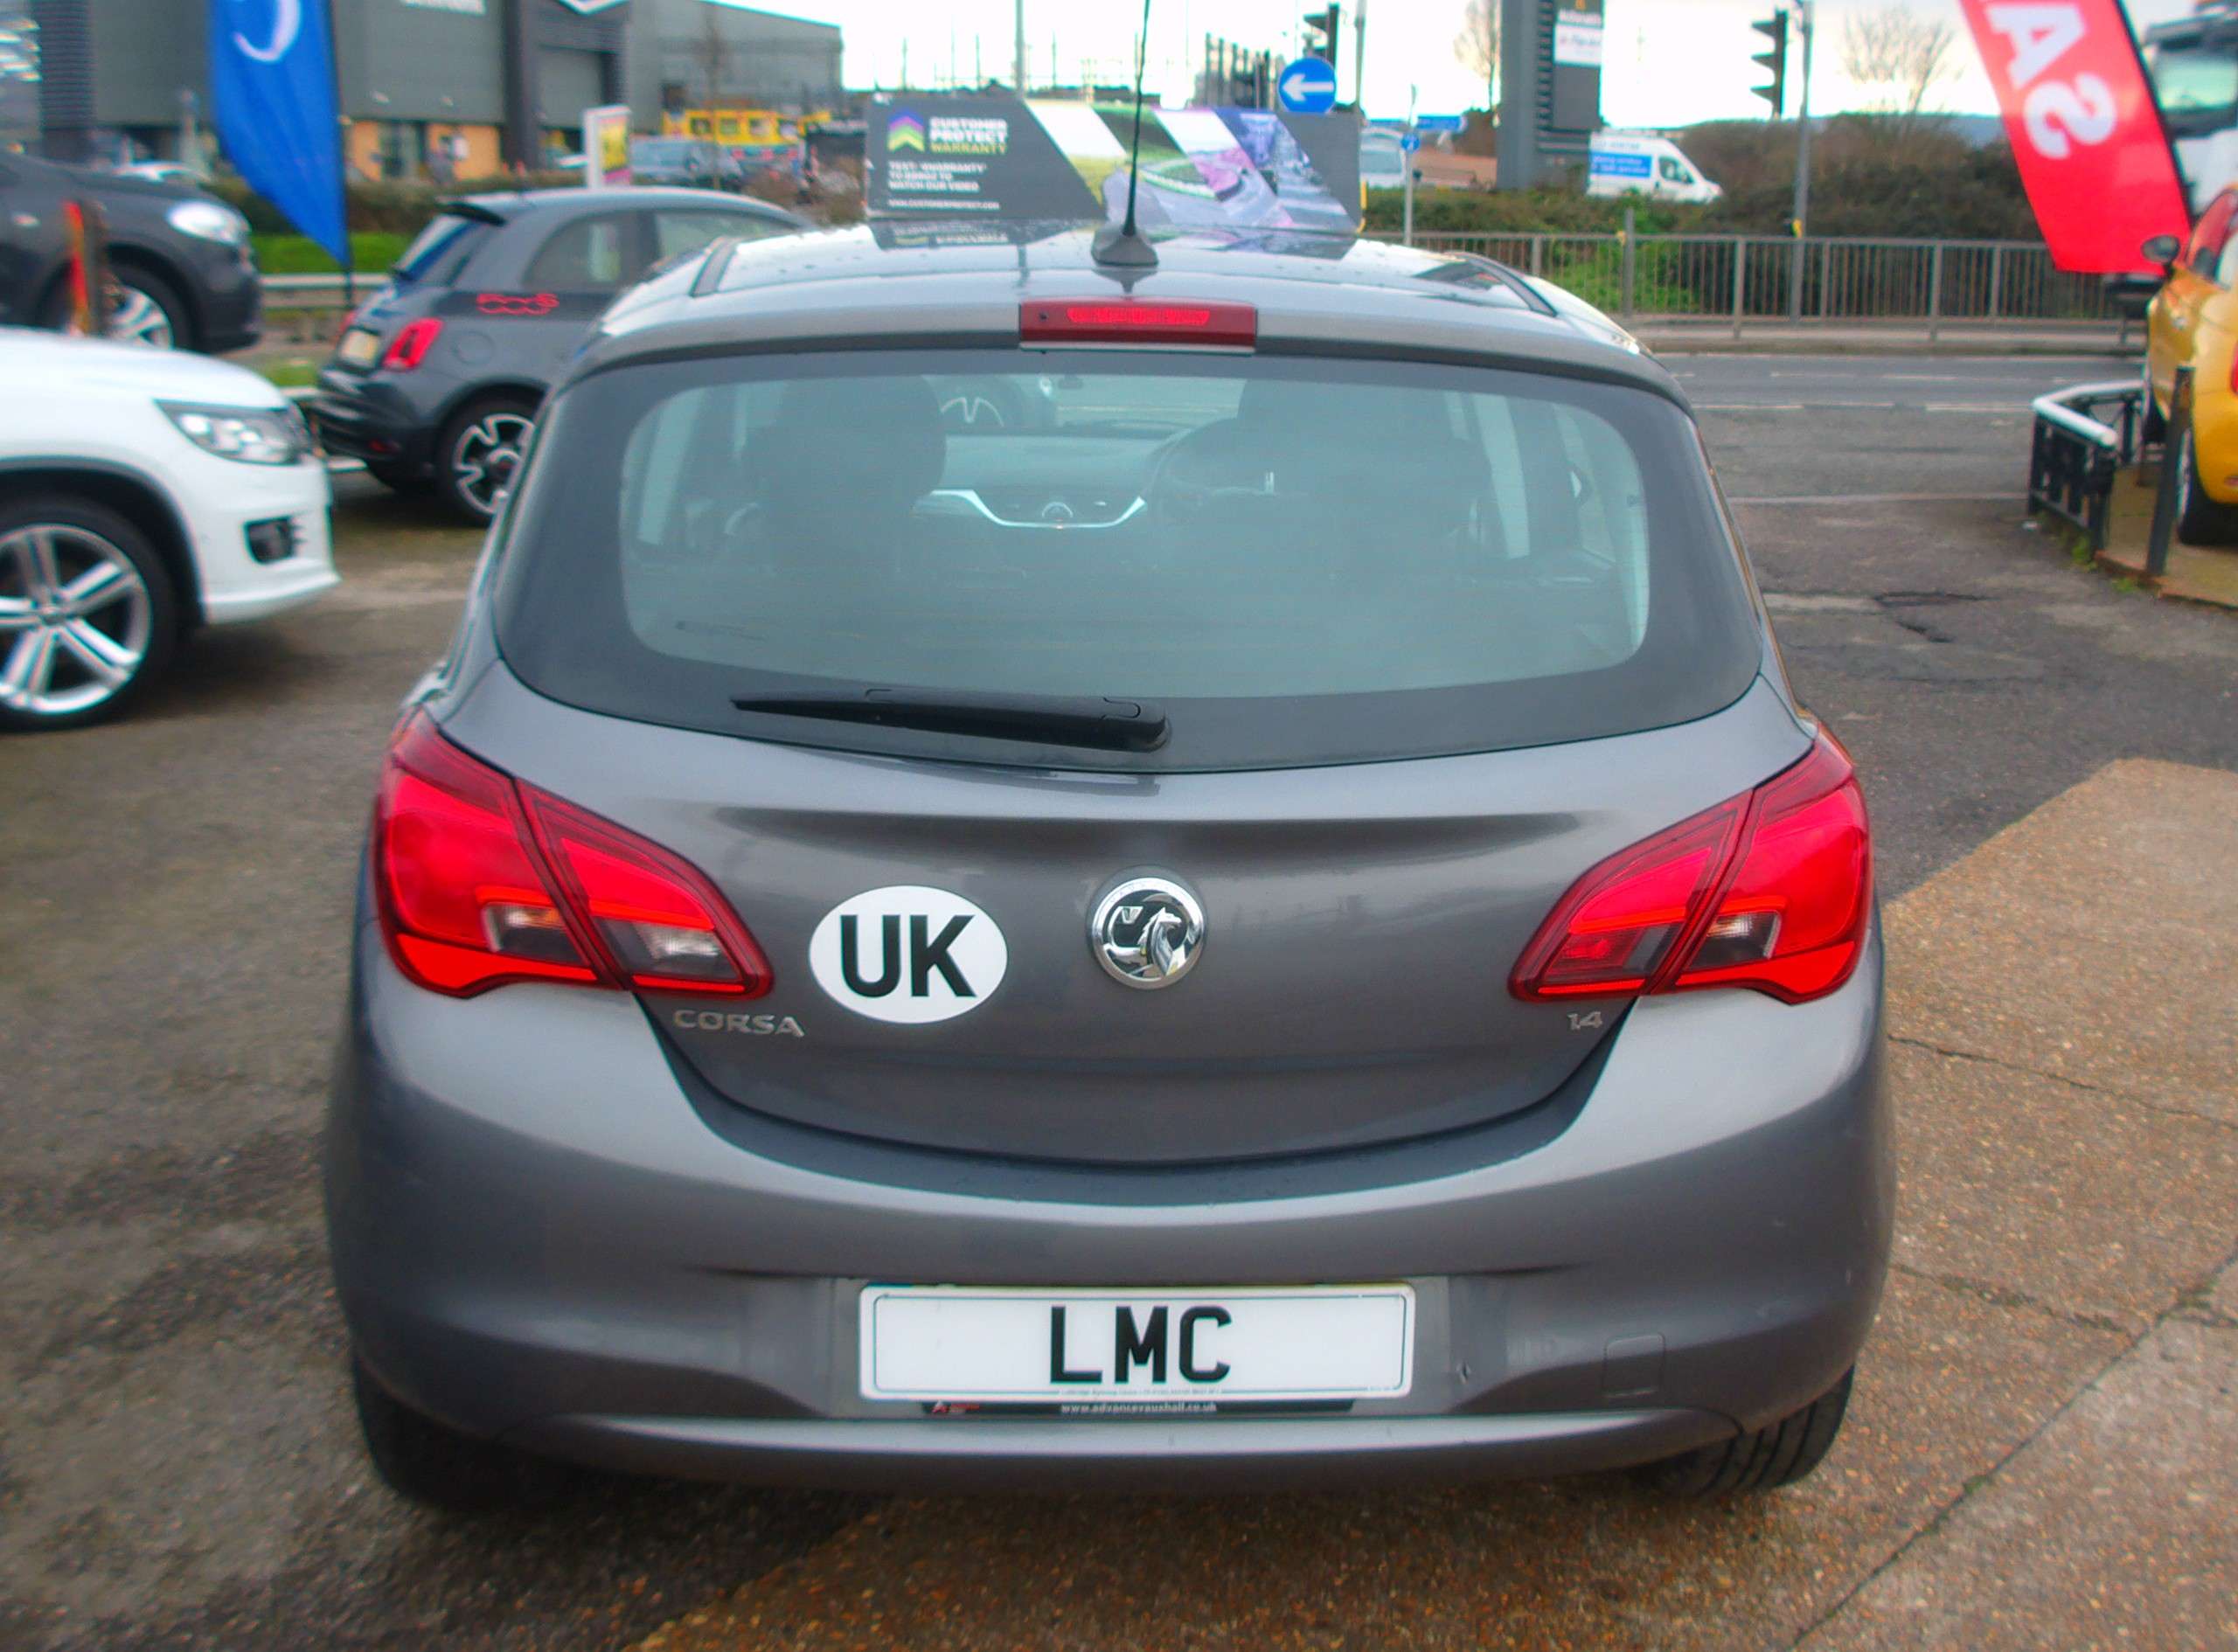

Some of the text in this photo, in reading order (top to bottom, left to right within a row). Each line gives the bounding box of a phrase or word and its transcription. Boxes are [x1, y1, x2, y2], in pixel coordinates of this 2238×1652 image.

[929, 116, 1007, 129] CUSTOMER
[929, 129, 1007, 142] PROTECT
[929, 142, 1007, 154] WARRANTY
[839, 913, 977, 998] UK
[673, 1009, 805, 1038] CORSA
[1050, 1306, 1232, 1385] LMC
[1060, 1400, 1218, 1414] www.advancevauxhall.co.uk
